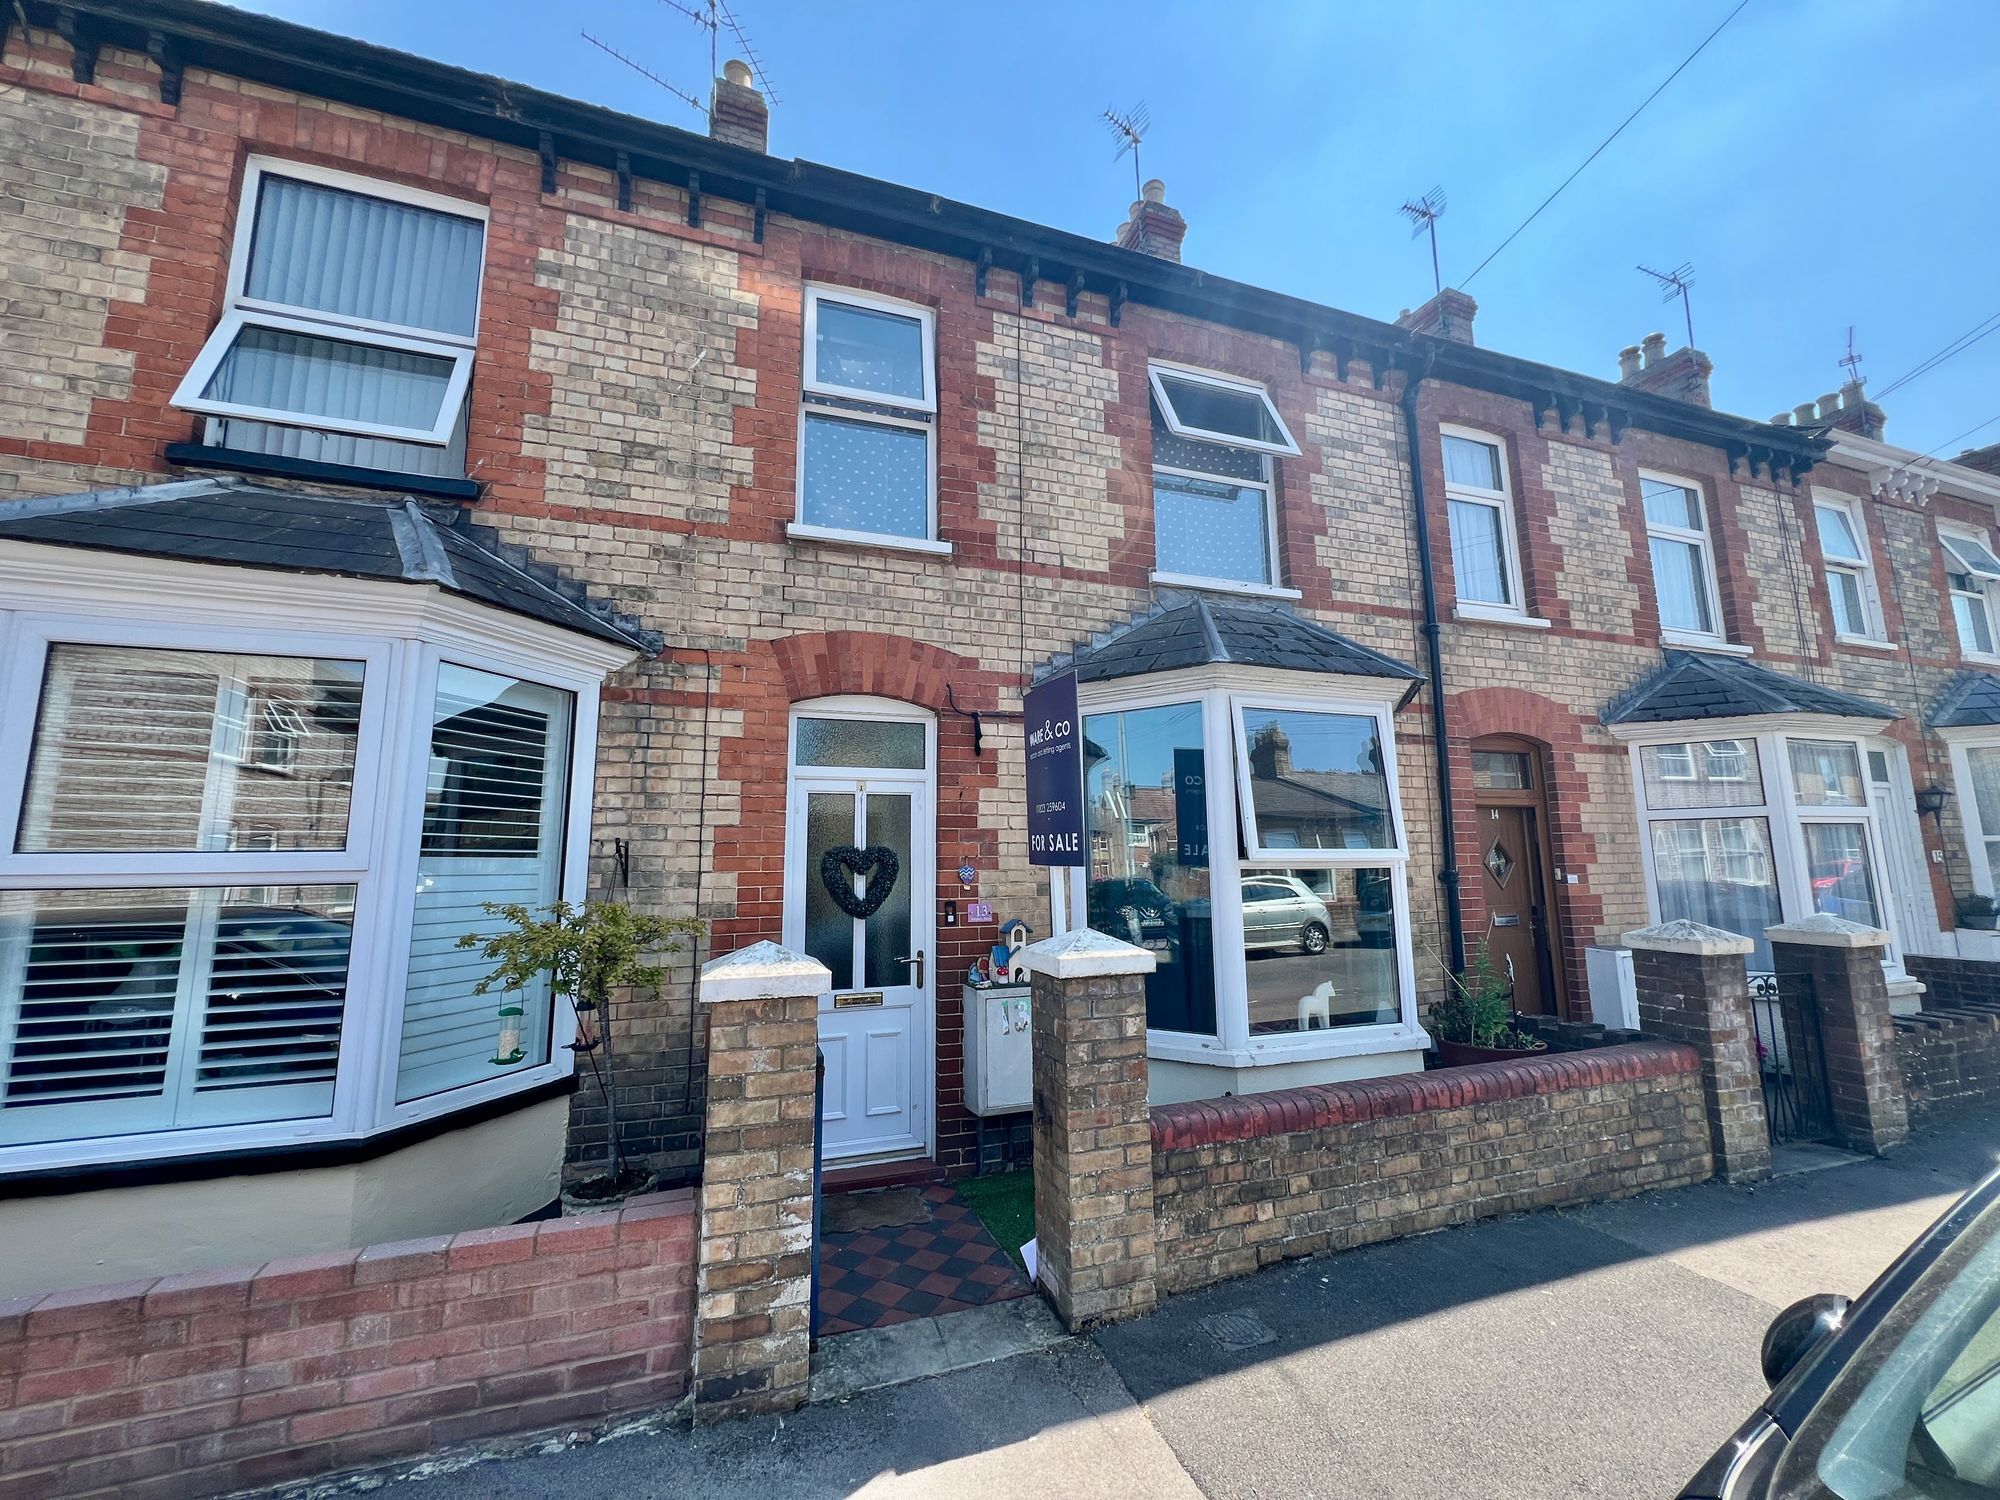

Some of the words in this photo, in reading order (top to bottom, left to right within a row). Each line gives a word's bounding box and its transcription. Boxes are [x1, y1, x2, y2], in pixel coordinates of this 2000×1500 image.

[1045, 719, 1053, 741] &
[1055, 720, 1070, 738] CO
[1046, 801, 1066, 812] 259604
[1491, 809, 1499, 820] 14
[1031, 834, 1045, 852] FOR
[1049, 833, 1078, 852] SALE
[976, 905, 988, 917] 13
